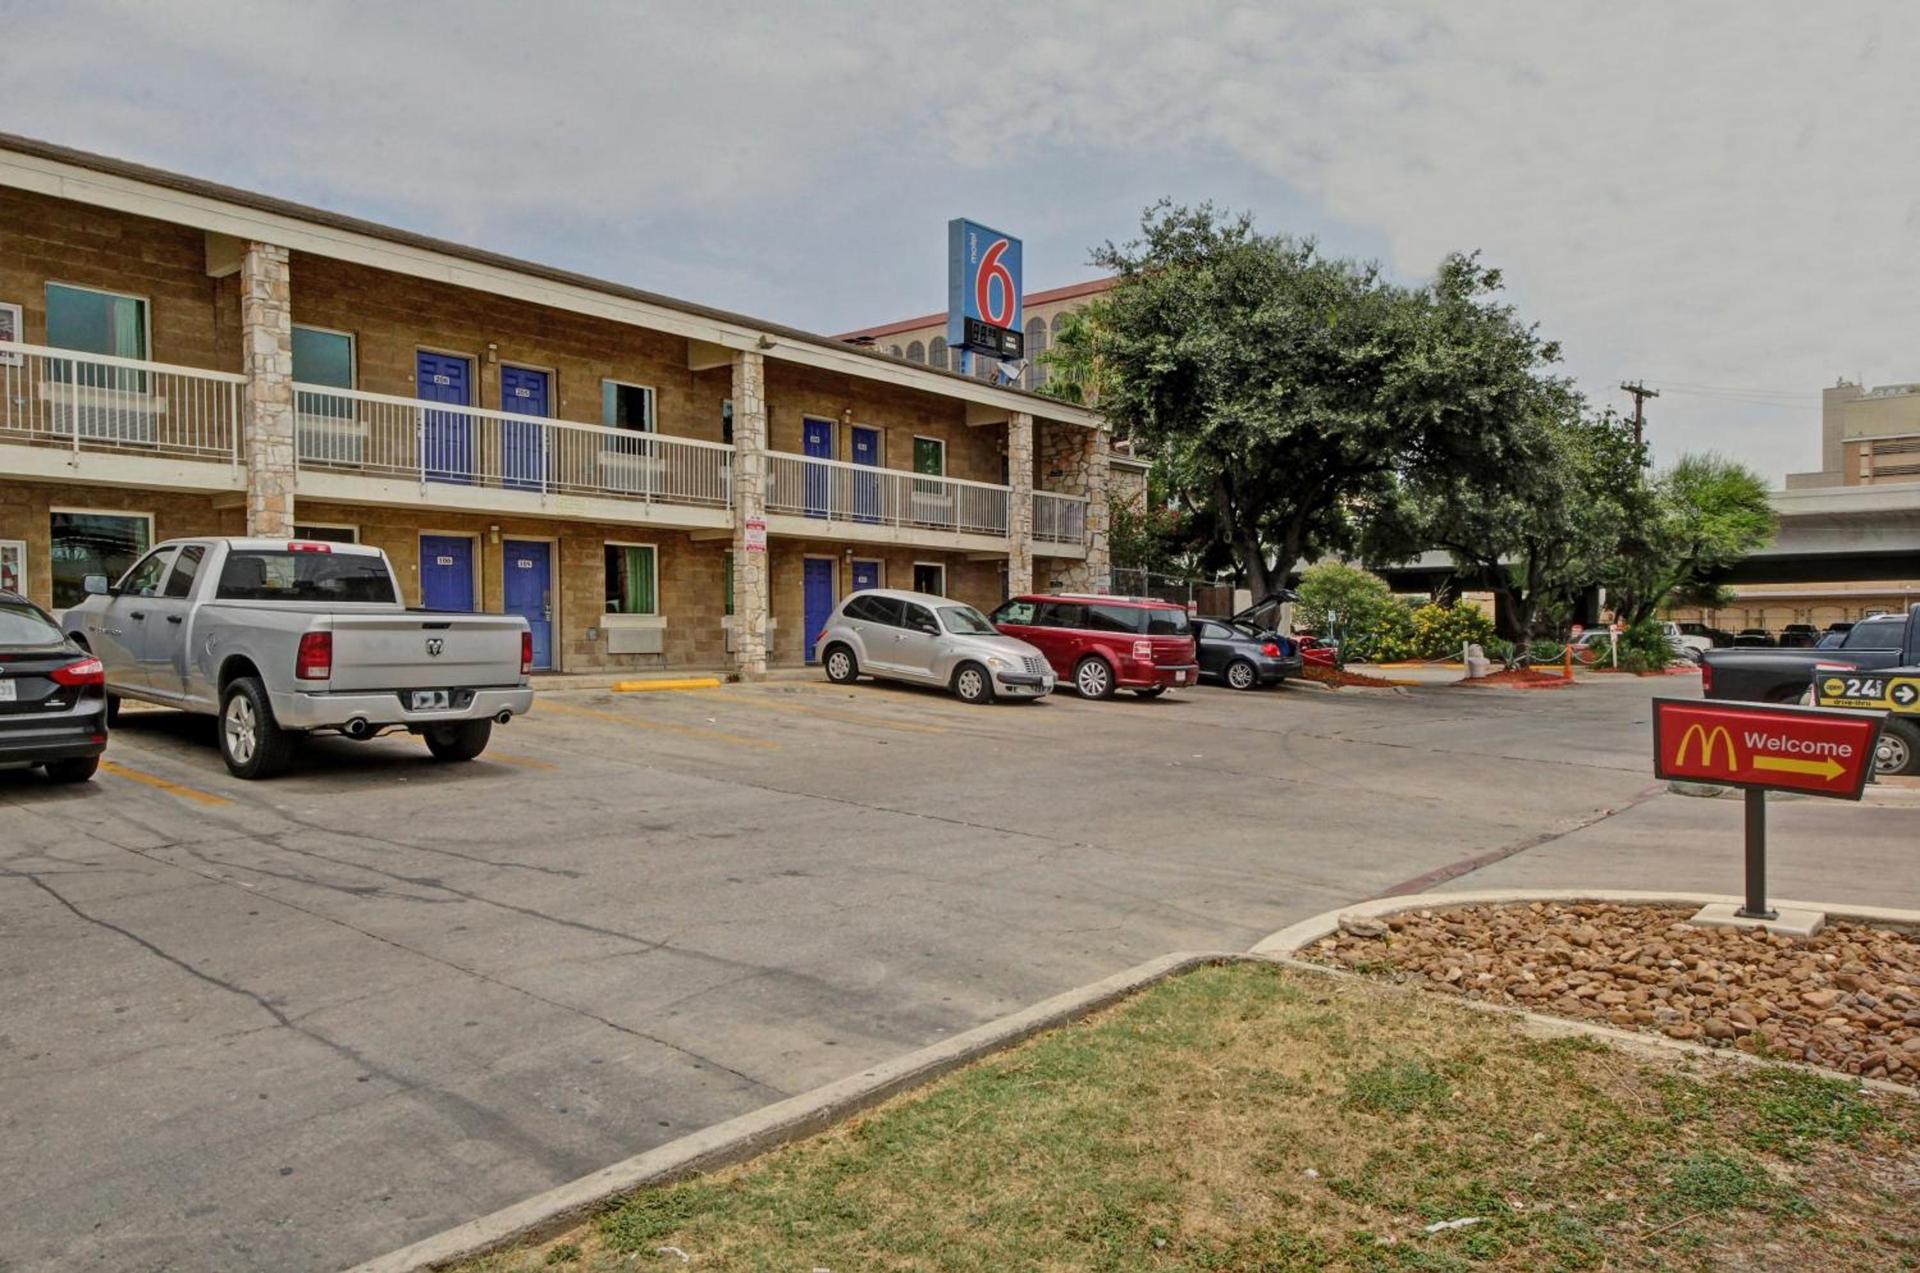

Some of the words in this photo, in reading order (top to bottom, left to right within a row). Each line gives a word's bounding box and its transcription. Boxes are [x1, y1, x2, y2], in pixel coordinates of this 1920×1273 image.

[976, 239, 1015, 329] 6
[1846, 679, 1876, 697] 24
[1743, 732, 1852, 757] Welcome
